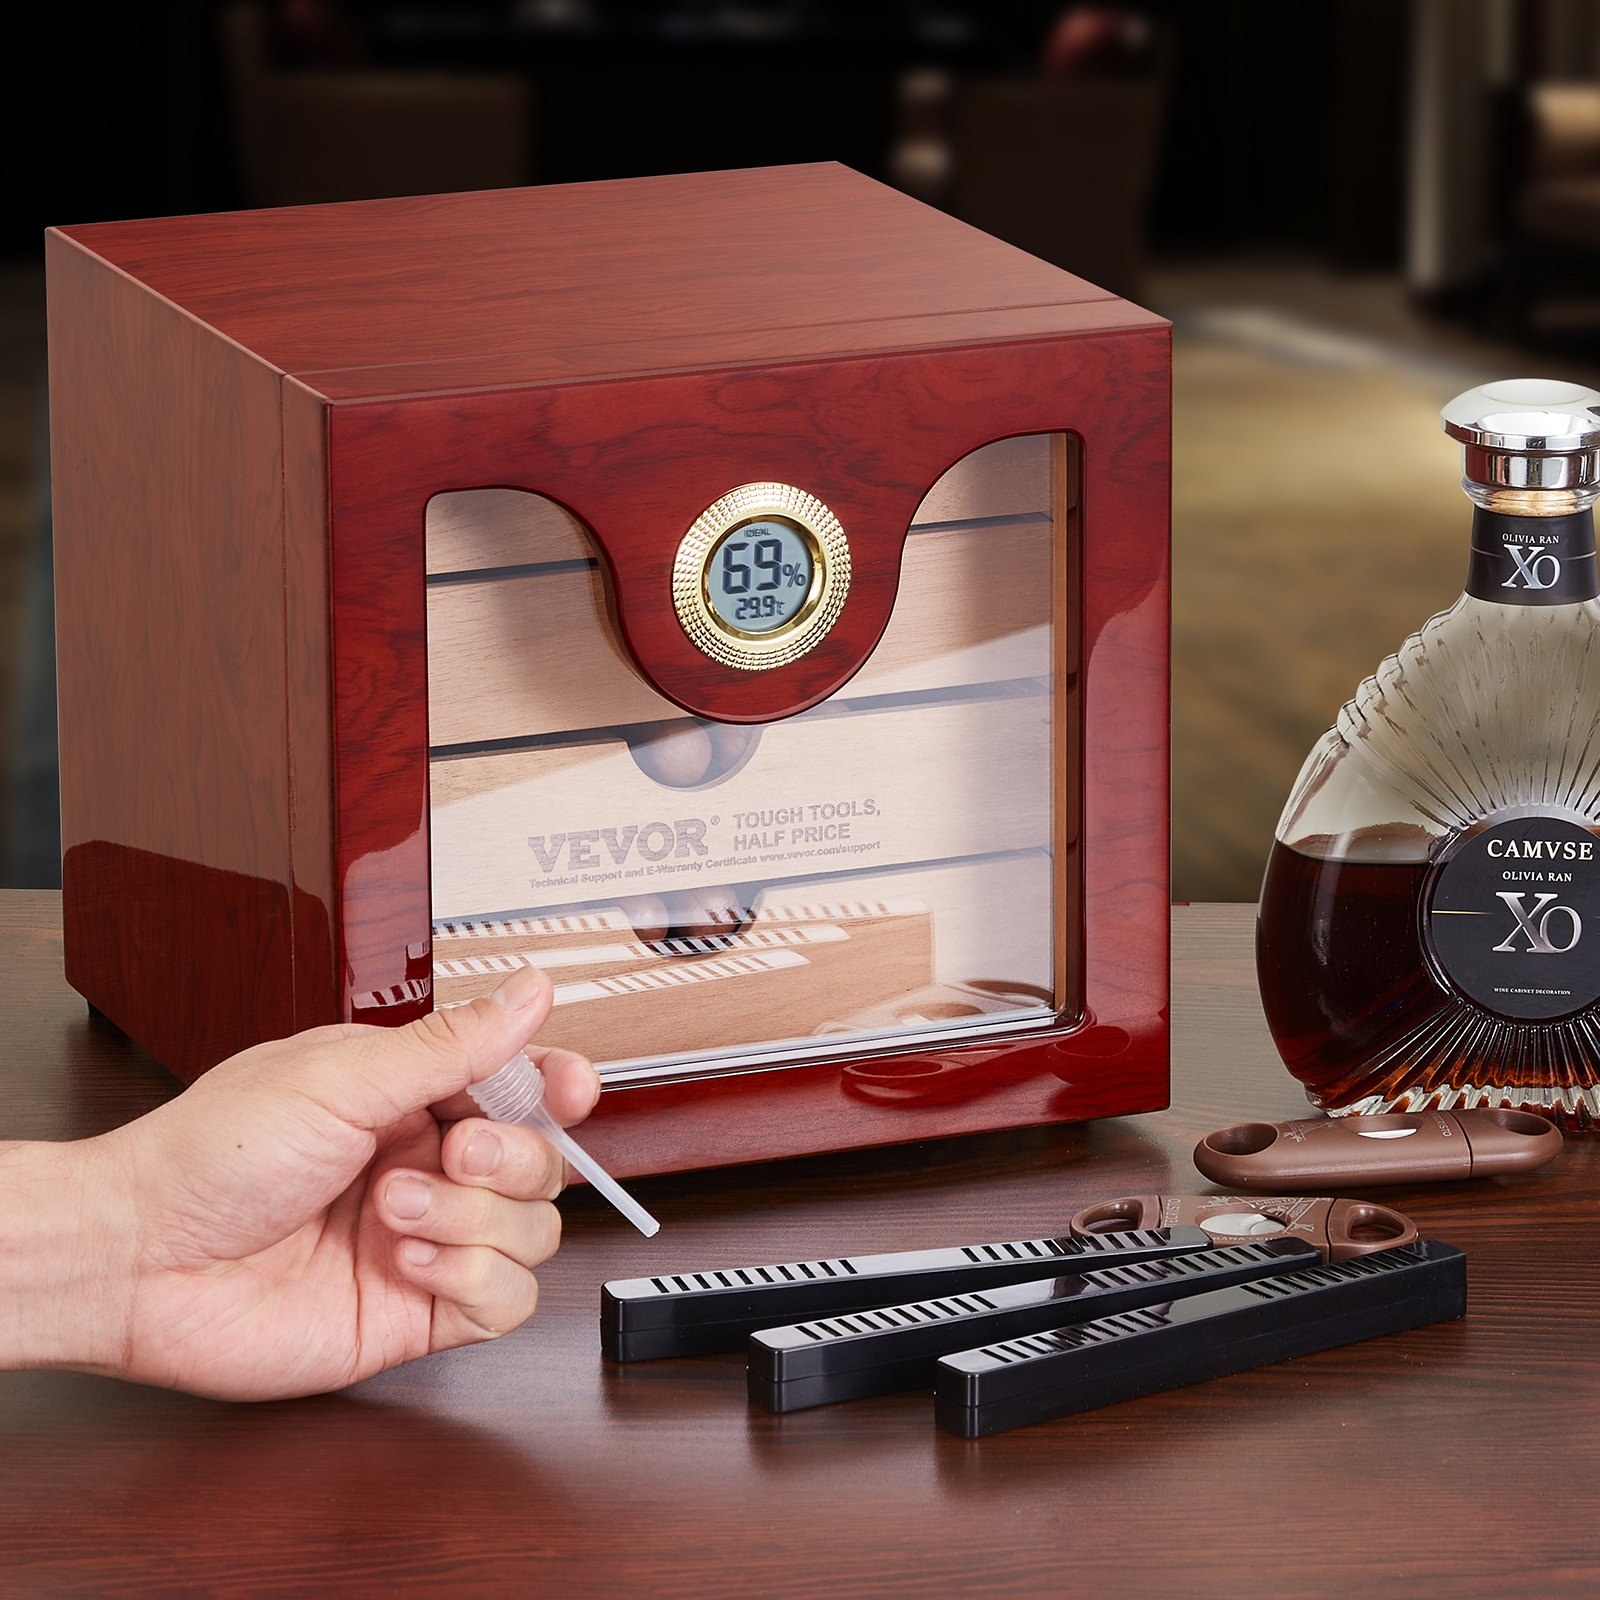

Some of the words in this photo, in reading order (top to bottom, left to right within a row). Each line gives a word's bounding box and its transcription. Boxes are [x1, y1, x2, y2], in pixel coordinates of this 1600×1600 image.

[744, 528, 771, 538] IDEAL
[1502, 533, 1536, 544] OLIVIA
[1539, 535, 1560, 544] RAN
[732, 806, 804, 830] TOUGH
[809, 798, 881, 822] TOOLS,
[733, 830, 786, 851] HALF
[791, 823, 851, 845] PRICE
[1487, 838, 1594, 861] CAMVSE
[529, 874, 579, 889] Technical
[581, 869, 623, 884] Support
[624, 867, 644, 879] and
[646, 861, 703, 876] E-Warranty
[705, 856, 758, 869] Certificate
[760, 840, 881, 863] www.vevor.com/support
[1502, 870, 1544, 882] OLIVIA
[1548, 871, 1573, 882] RAN
